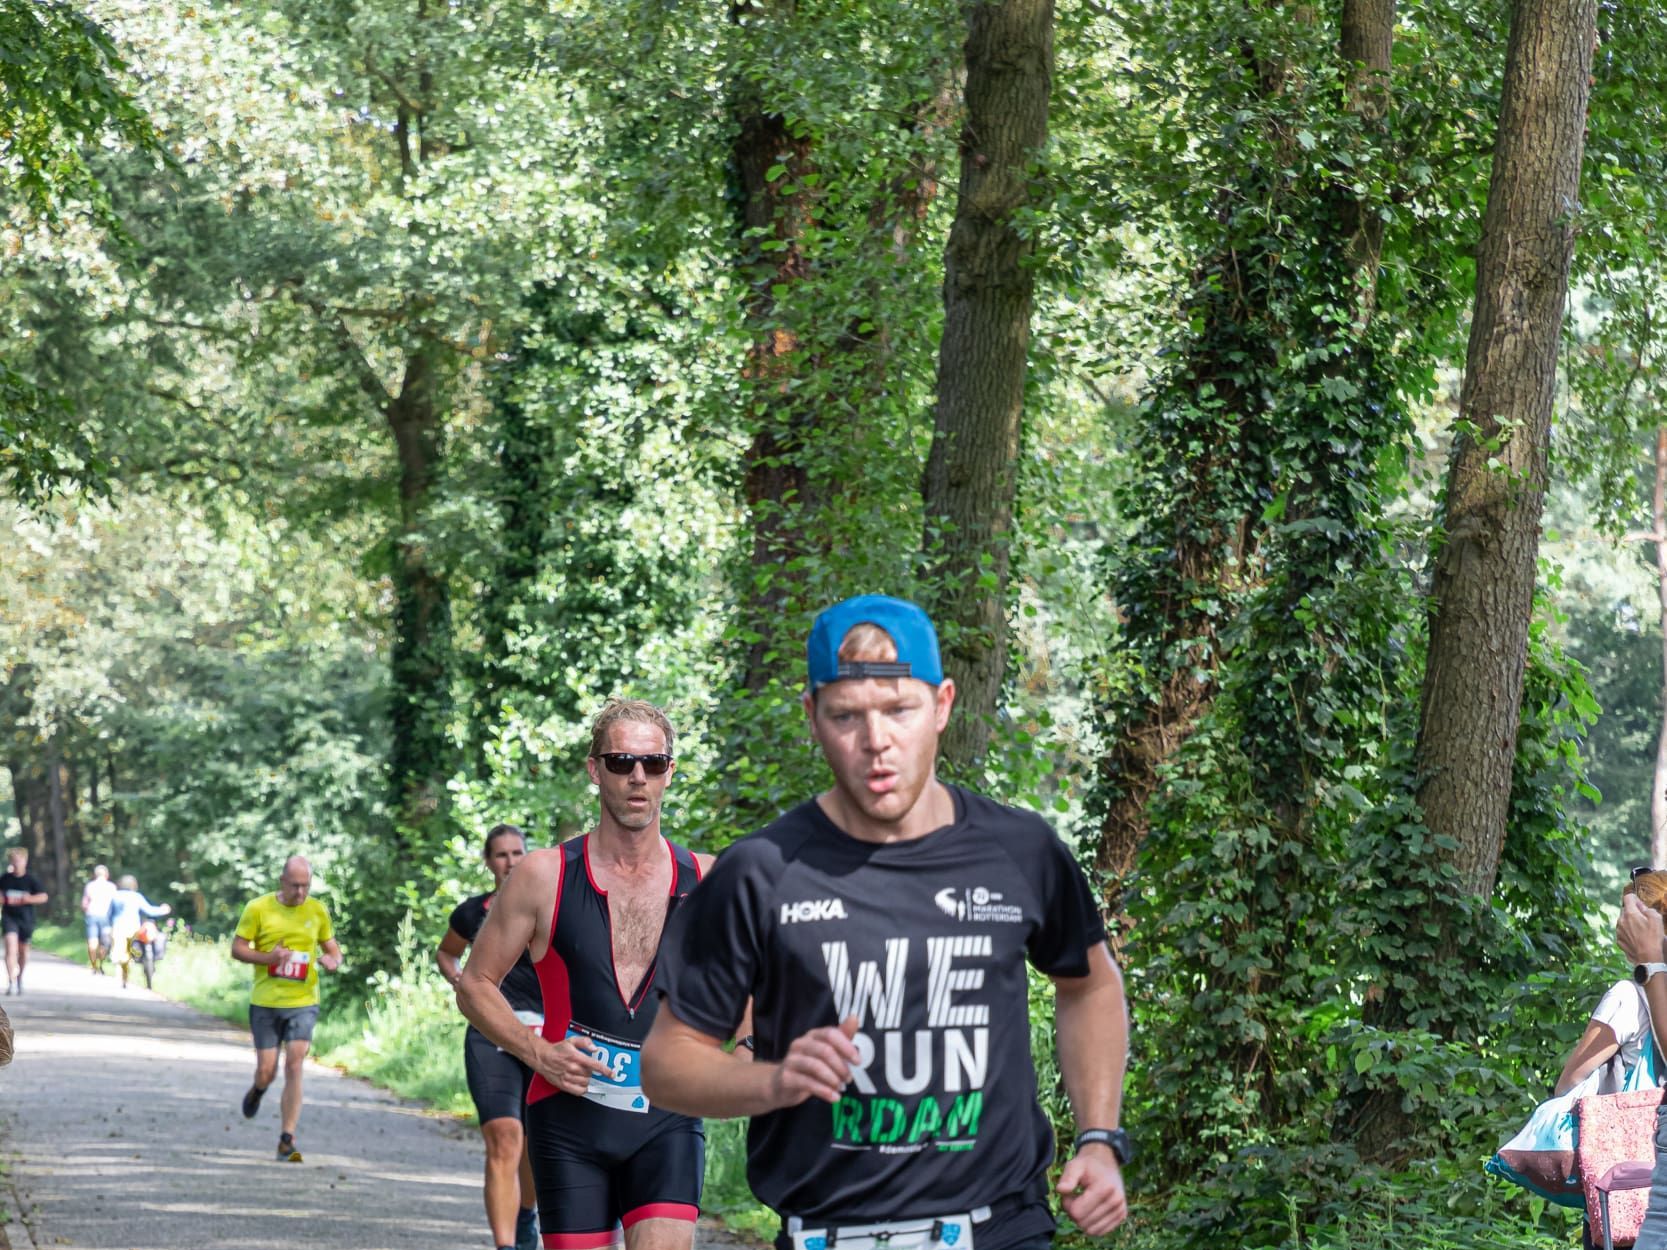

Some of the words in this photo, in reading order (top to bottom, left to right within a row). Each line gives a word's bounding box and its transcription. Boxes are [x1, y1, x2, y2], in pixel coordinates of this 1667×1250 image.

[780, 898, 846, 924] HOKA
[973, 904, 1022, 915] MARATHON
[973, 913, 1022, 923] ROTTERDAM
[821, 936, 992, 1029] WE
[838, 1028, 989, 1094] RUN
[832, 1091, 983, 1143] RDAM
